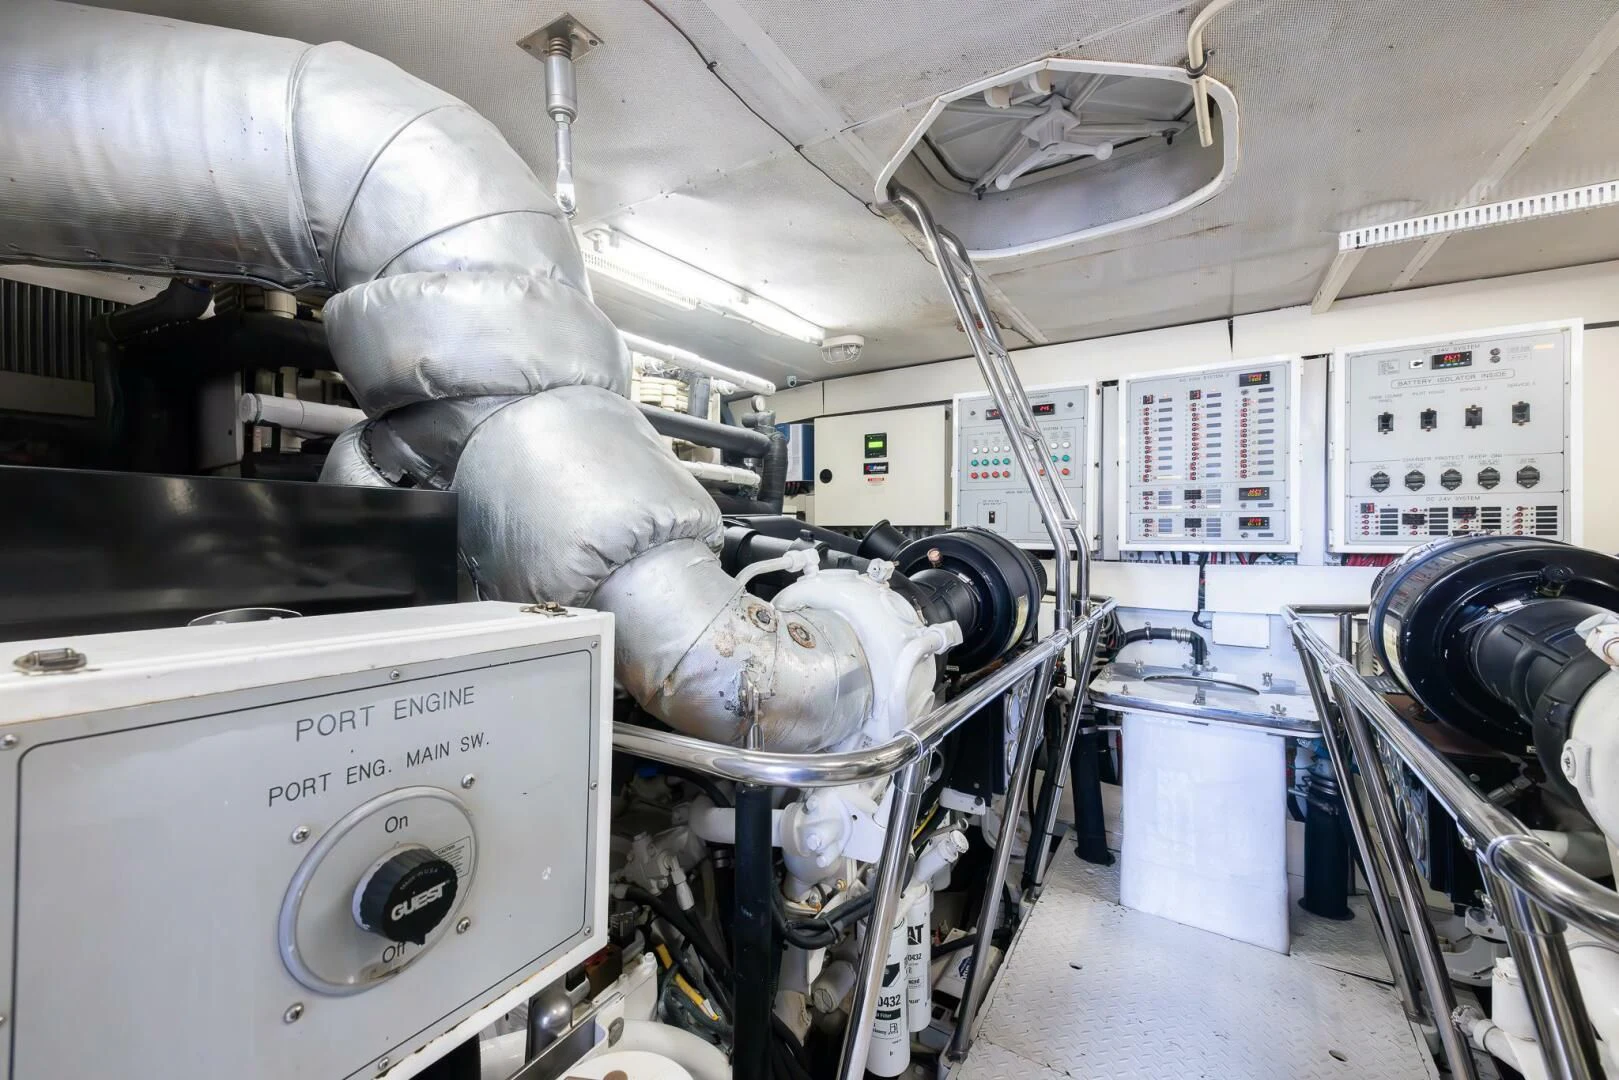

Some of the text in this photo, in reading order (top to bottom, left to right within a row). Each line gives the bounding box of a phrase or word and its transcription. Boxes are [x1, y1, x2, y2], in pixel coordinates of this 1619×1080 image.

[1397, 371, 1508, 387] BATTERY ISOLATOR INSIDE
[296, 685, 475, 742] PORT ENGINE
[268, 732, 490, 807] PORT ENG. MAIN SW.
[384, 815, 408, 833] On
[391, 881, 446, 921] GUEST
[907, 923, 924, 945] AT
[382, 941, 406, 963] Off
[907, 953, 922, 961] 0432
[877, 994, 901, 1008] 0432
